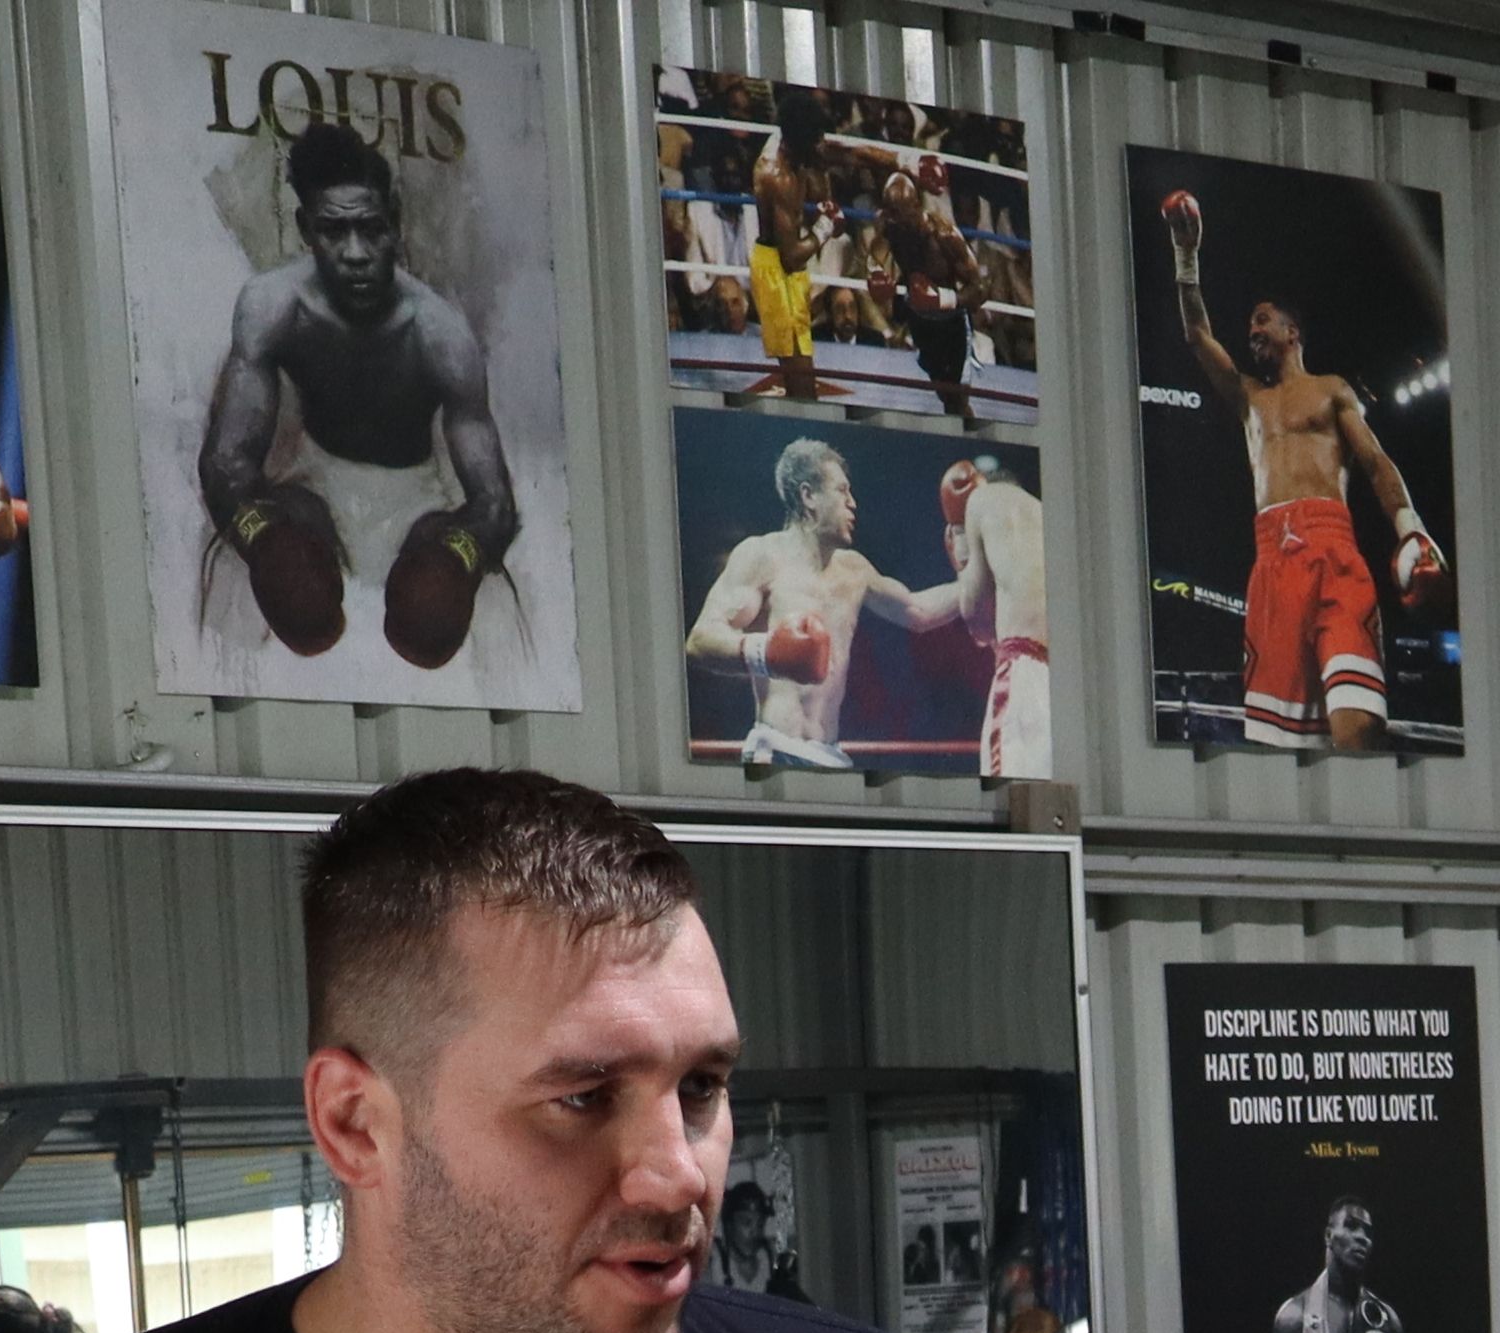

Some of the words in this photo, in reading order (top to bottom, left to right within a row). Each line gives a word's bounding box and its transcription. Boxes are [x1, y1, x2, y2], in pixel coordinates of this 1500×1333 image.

[202, 51, 467, 162] LOUIS
[1140, 385, 1201, 409] BOXING
[1204, 1009, 1299, 1037] DISCIPLINE
[1302, 1009, 1319, 1037] IS
[1321, 1009, 1371, 1037] DOING
[1373, 1009, 1417, 1037] WHAT
[1420, 1010, 1450, 1037] YOU
[1204, 1053, 1251, 1081] HATE
[1254, 1053, 1277, 1080] TO
[1280, 1053, 1310, 1084] DO,
[1313, 1052, 1344, 1080] BUT
[1348, 1051, 1453, 1080] NONETHELESS
[1229, 1096, 1283, 1124] DOING
[1286, 1096, 1303, 1123] IT
[1307, 1095, 1343, 1123] LIKE
[1345, 1095, 1378, 1122] YOU
[1380, 1095, 1418, 1122] LOVE
[1419, 1094, 1438, 1121] IT.
[1345, 1142, 1380, 1160] Tyson
